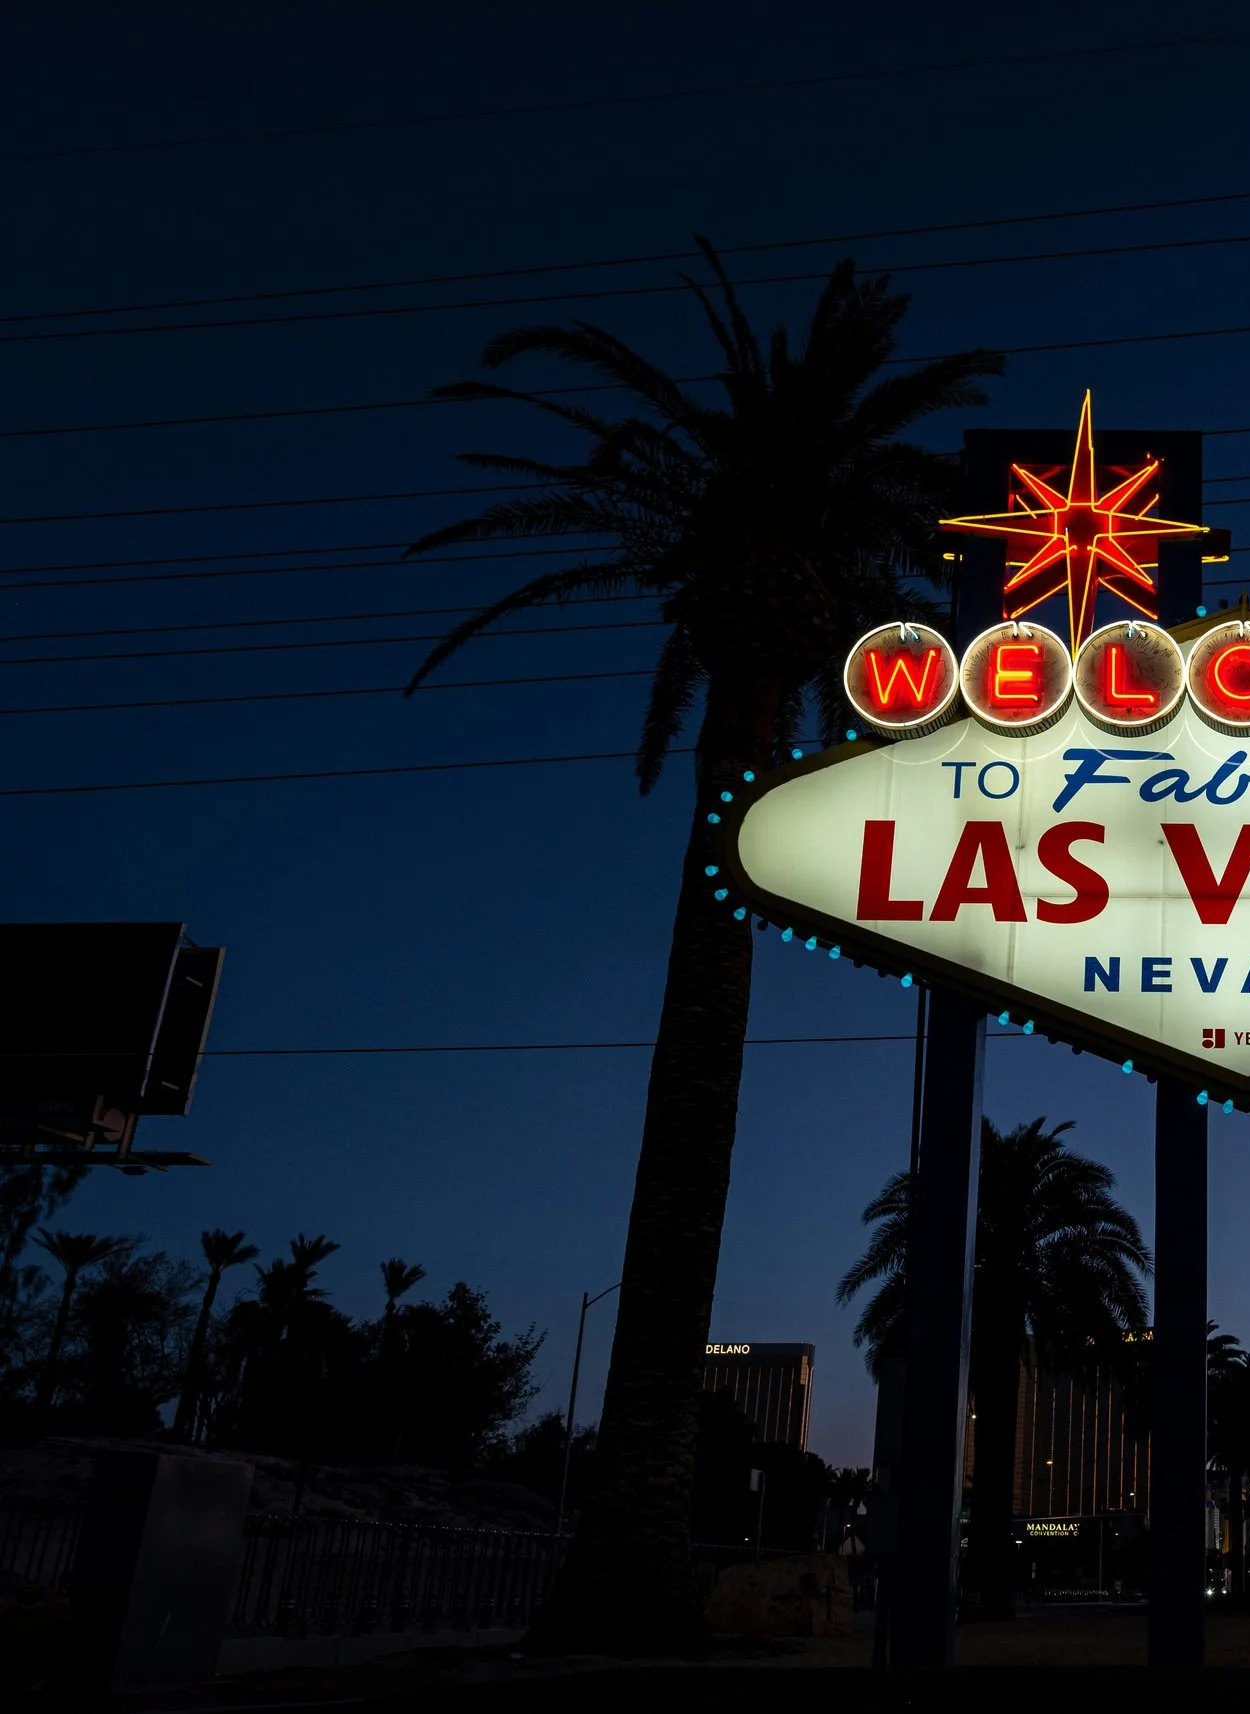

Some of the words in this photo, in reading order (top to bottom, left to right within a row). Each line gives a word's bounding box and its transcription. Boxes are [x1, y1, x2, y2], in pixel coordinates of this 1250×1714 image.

[941, 762, 1019, 799] TO
[856, 820, 1109, 924] LAS
[705, 1344, 750, 1354] DELANO
[1026, 1523, 1080, 1531] MANDALAY
